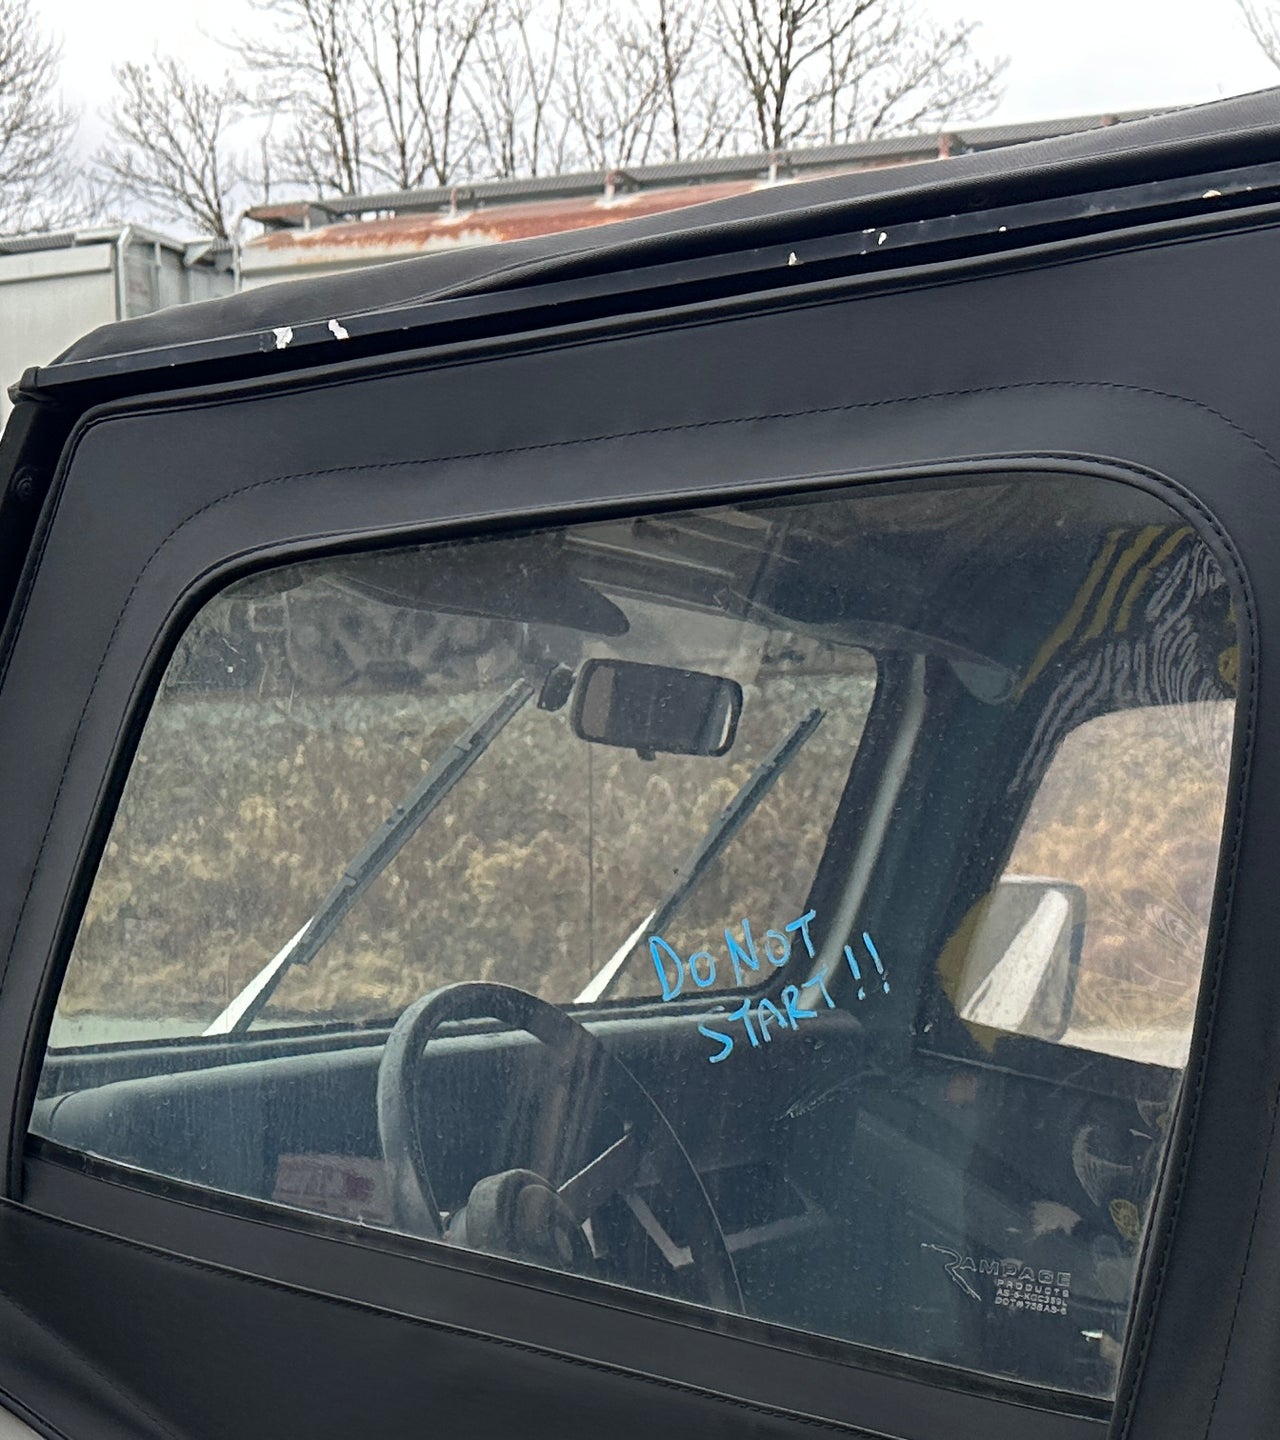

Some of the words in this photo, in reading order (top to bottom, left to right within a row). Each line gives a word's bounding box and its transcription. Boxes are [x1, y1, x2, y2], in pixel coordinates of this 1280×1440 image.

[724, 908, 817, 987] NOT
[920, 1243, 1071, 1301] RAMPAGE
[996, 1279, 1070, 1298] PRODUCTS
